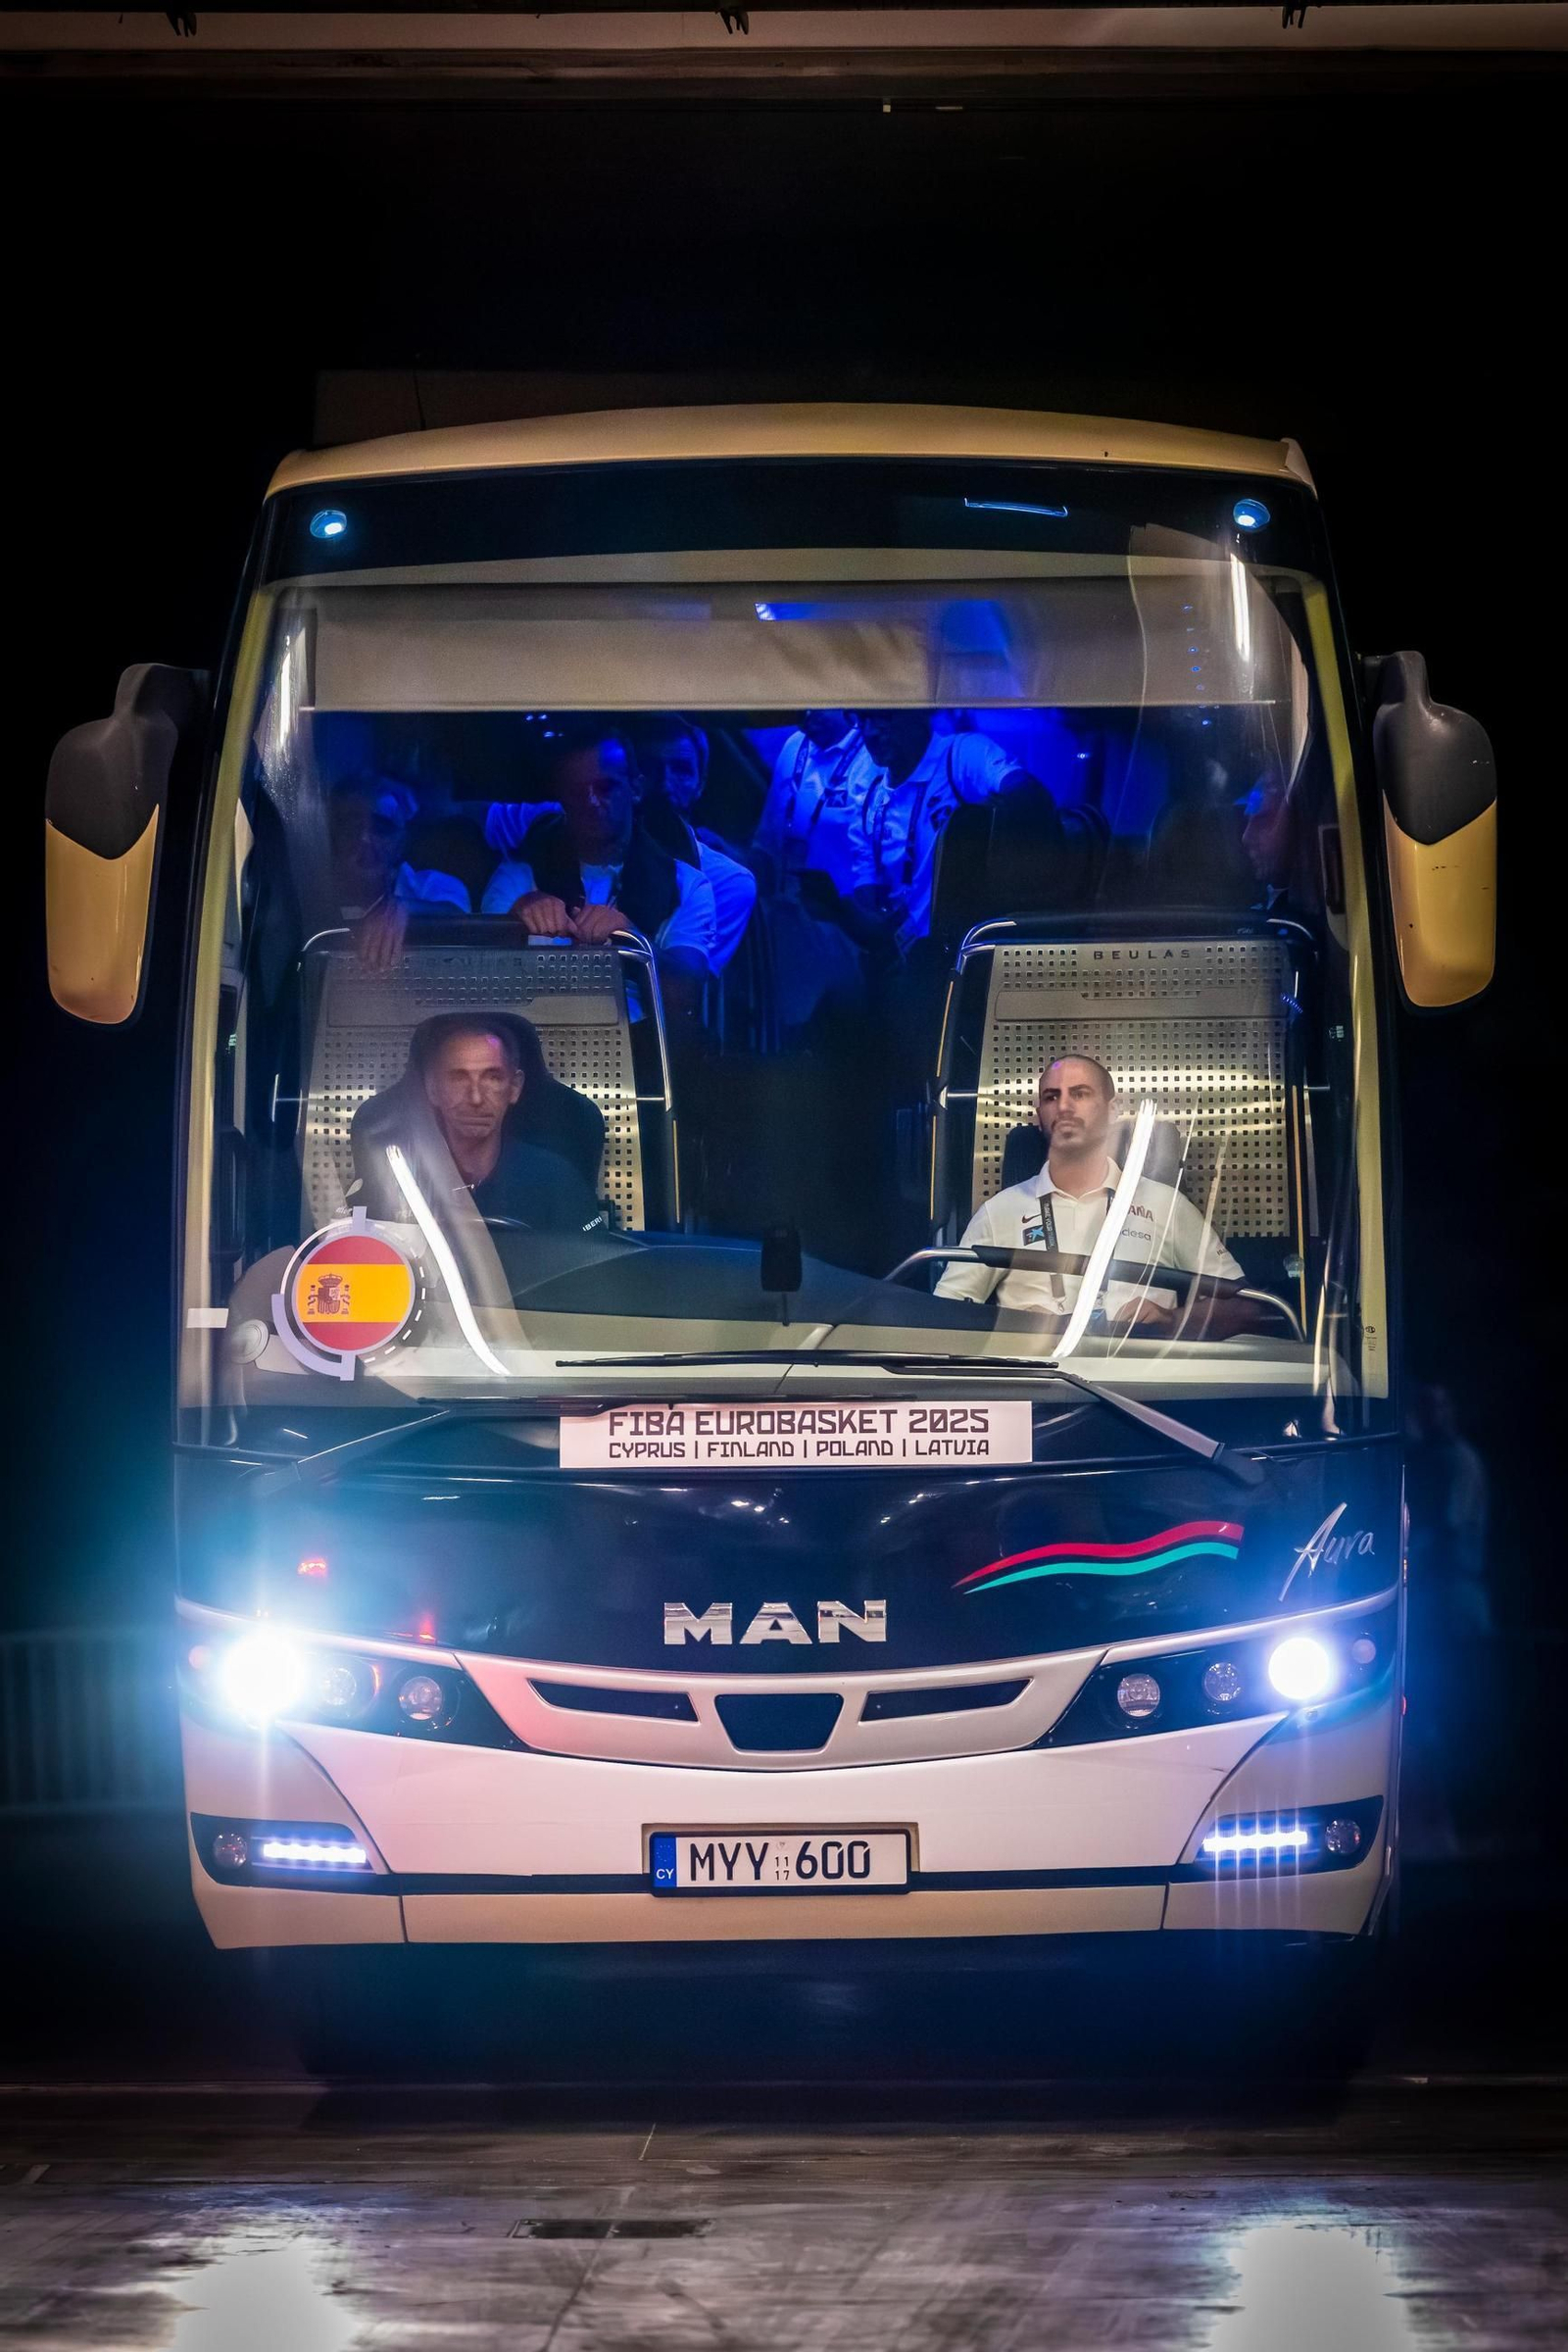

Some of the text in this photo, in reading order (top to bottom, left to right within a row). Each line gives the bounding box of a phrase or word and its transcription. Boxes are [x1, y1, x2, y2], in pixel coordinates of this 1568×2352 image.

[1093, 949, 1191, 959] BEULAS
[1128, 1204, 1154, 1222] AÑA
[1120, 1228, 1152, 1242] desa
[609, 1408, 990, 1437] FIBA EUROBASKET 2025
[609, 1442, 686, 1458] CYPRUS
[708, 1441, 795, 1458] FINLAND
[816, 1440, 894, 1457] POLAND
[915, 1439, 990, 1456] LATVIA
[1278, 1501, 1376, 1602] Aura
[663, 1599, 887, 1645] MAN
[656, 1840, 871, 1881] CY MYY 600
[774, 1856, 790, 1868] 11
[774, 1870, 790, 1881] 17
